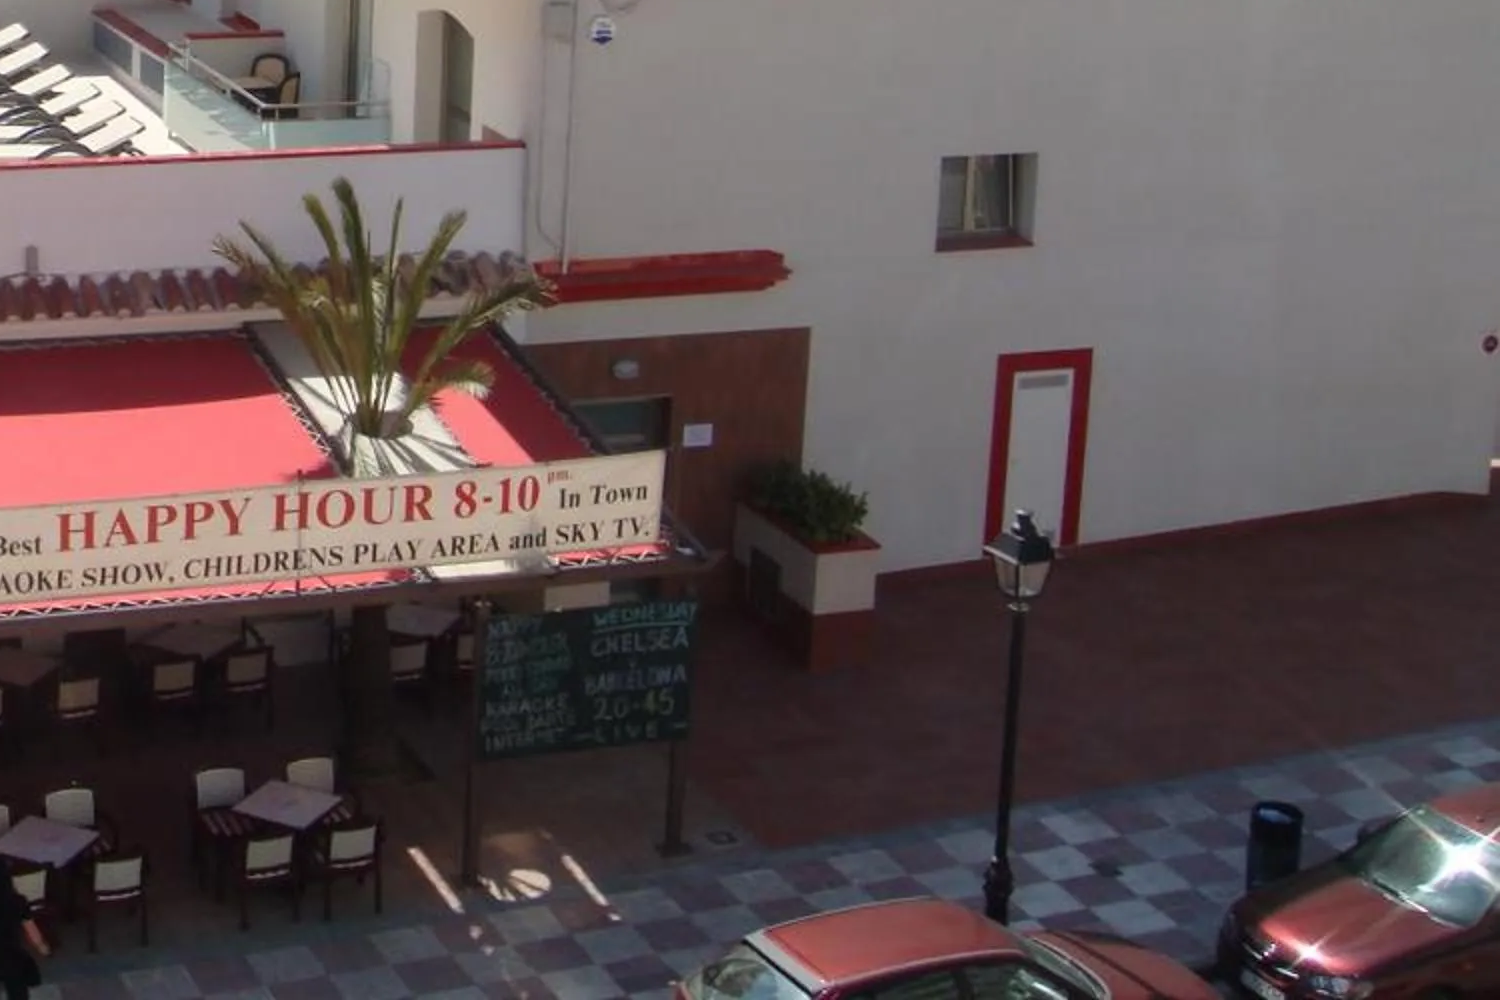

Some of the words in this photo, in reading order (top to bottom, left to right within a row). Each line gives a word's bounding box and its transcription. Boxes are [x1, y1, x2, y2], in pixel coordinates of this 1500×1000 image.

[56, 497, 252, 552] HAPPY
[271, 485, 434, 531] HOUR
[453, 474, 540, 519] 8-10
[558, 487, 581, 510] In
[589, 482, 648, 506] Town
[81, 562, 175, 588] SHOW,
[183, 545, 343, 580] CHILDRENS
[353, 539, 423, 565] PLAY
[434, 533, 500, 558] AREA
[508, 526, 547, 550] and
[554, 520, 605, 546] SKY
[591, 626, 689, 658] CHELSEA
